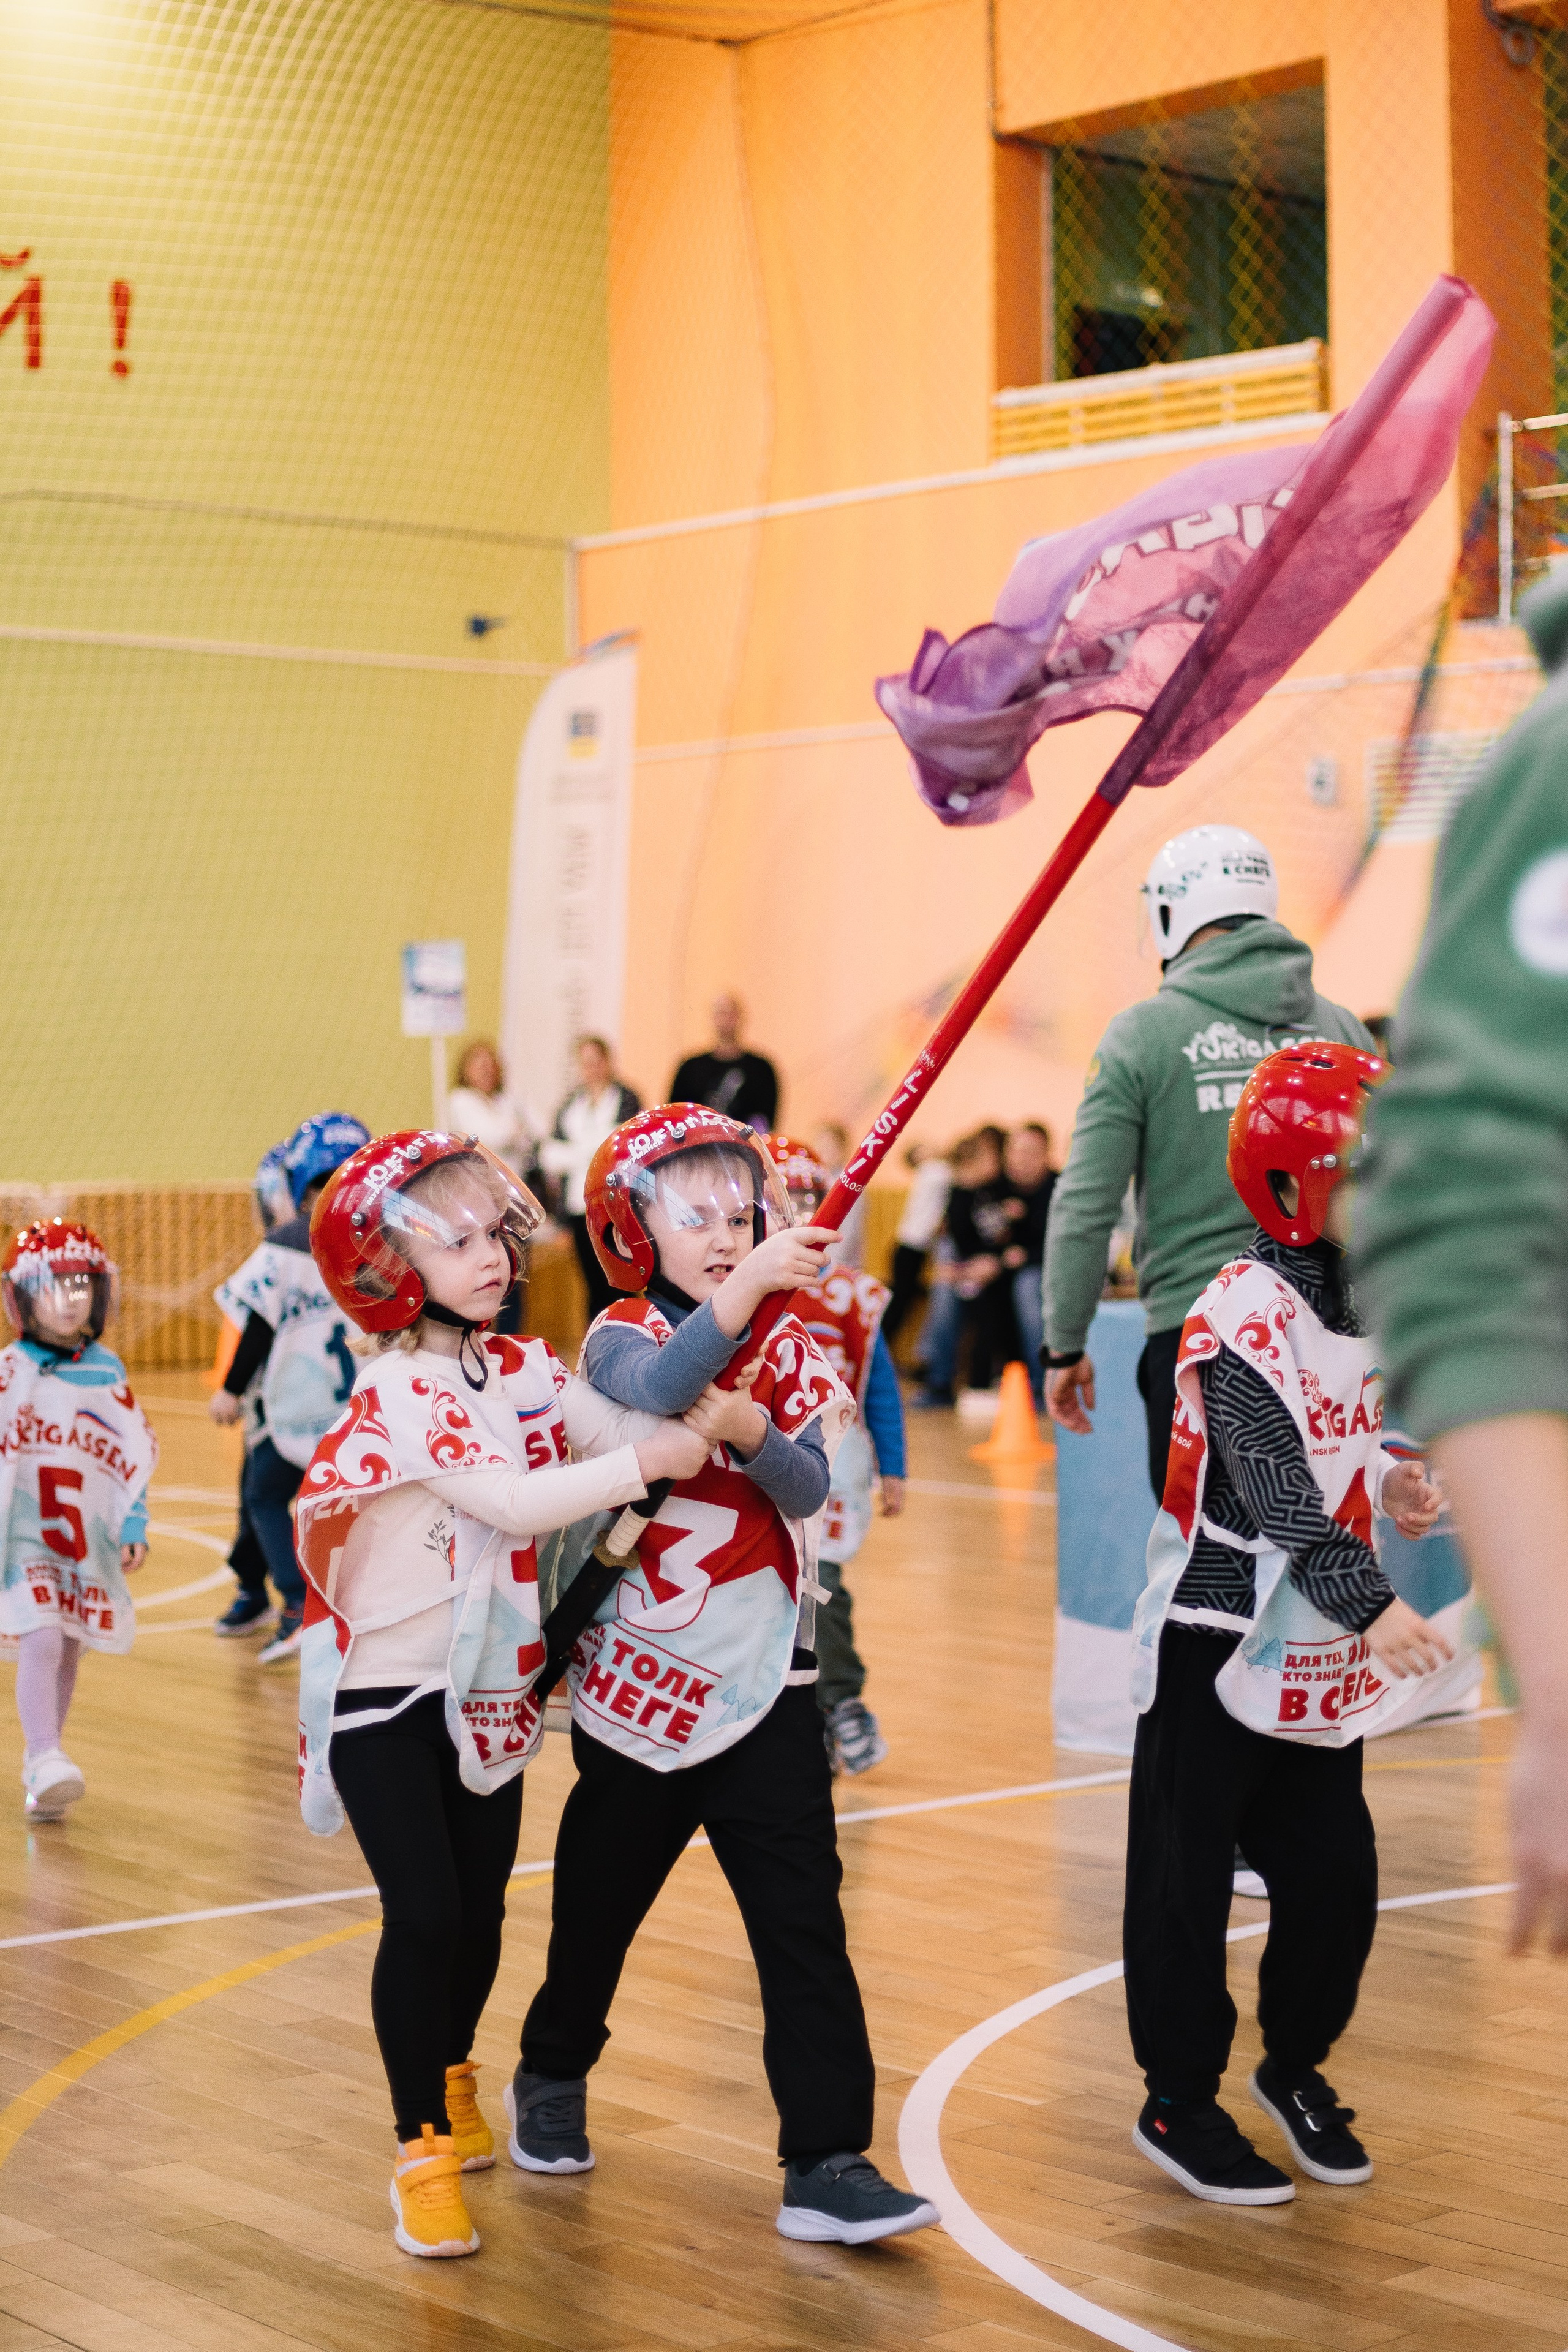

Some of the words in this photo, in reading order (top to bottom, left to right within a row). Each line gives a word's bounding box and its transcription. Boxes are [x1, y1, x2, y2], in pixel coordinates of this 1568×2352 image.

[848, 1069, 923, 1174] LISKI
[39, 1466, 87, 1562] 5
[611, 1637, 715, 1708] ТОЛК
[1282, 1671, 1313, 1682] КТО
[1284, 1654, 1322, 1669] ДЛЯ
[461, 1701, 498, 1715] ДЛЯ
[583, 1660, 700, 1744] НЕГЕ
[1278, 1688, 1310, 1722] В
[466, 1717, 491, 1727] ТО
